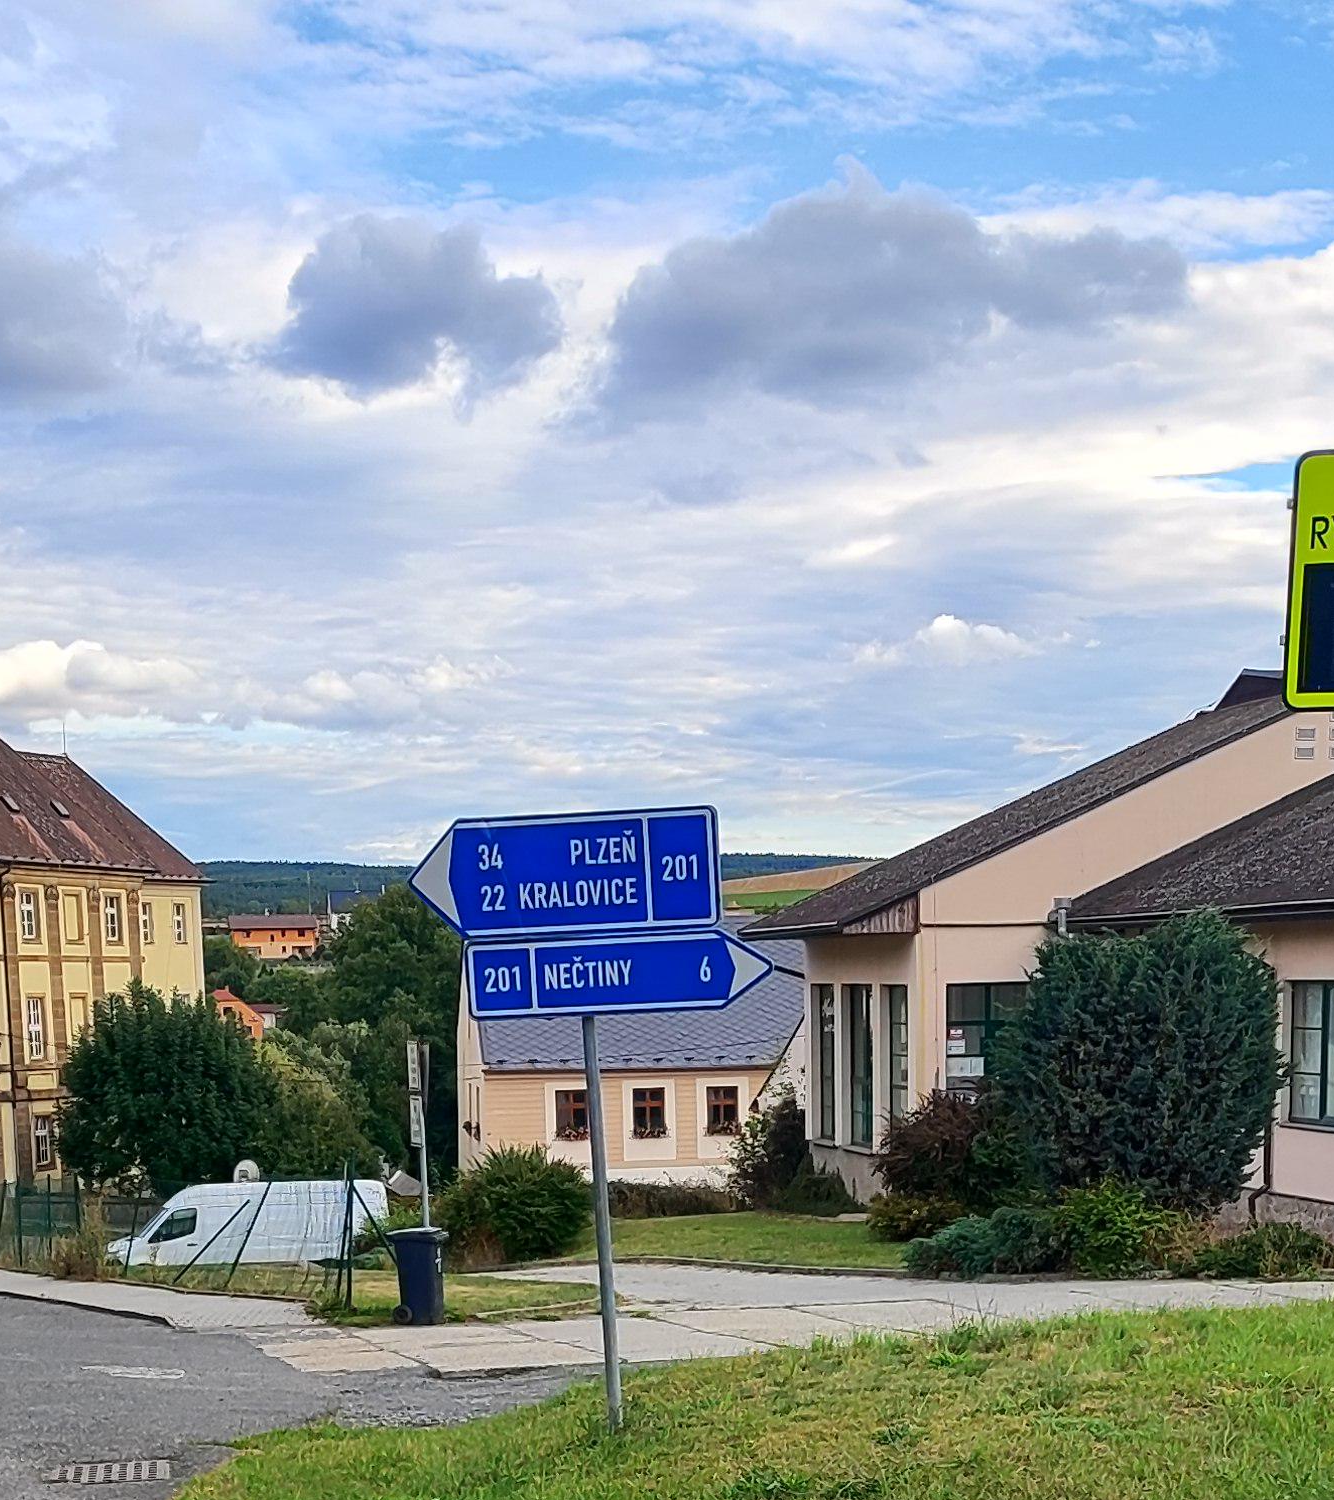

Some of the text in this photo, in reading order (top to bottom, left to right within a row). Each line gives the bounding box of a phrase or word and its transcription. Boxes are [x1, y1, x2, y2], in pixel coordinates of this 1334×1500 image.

[477, 830, 637, 871] 34 PLZEŇ
[661, 854, 699, 882] 201
[480, 877, 638, 912] 22 KRALOVICE
[484, 965, 522, 993] 201
[544, 956, 632, 990] NEČTINY
[699, 956, 712, 982] 6
